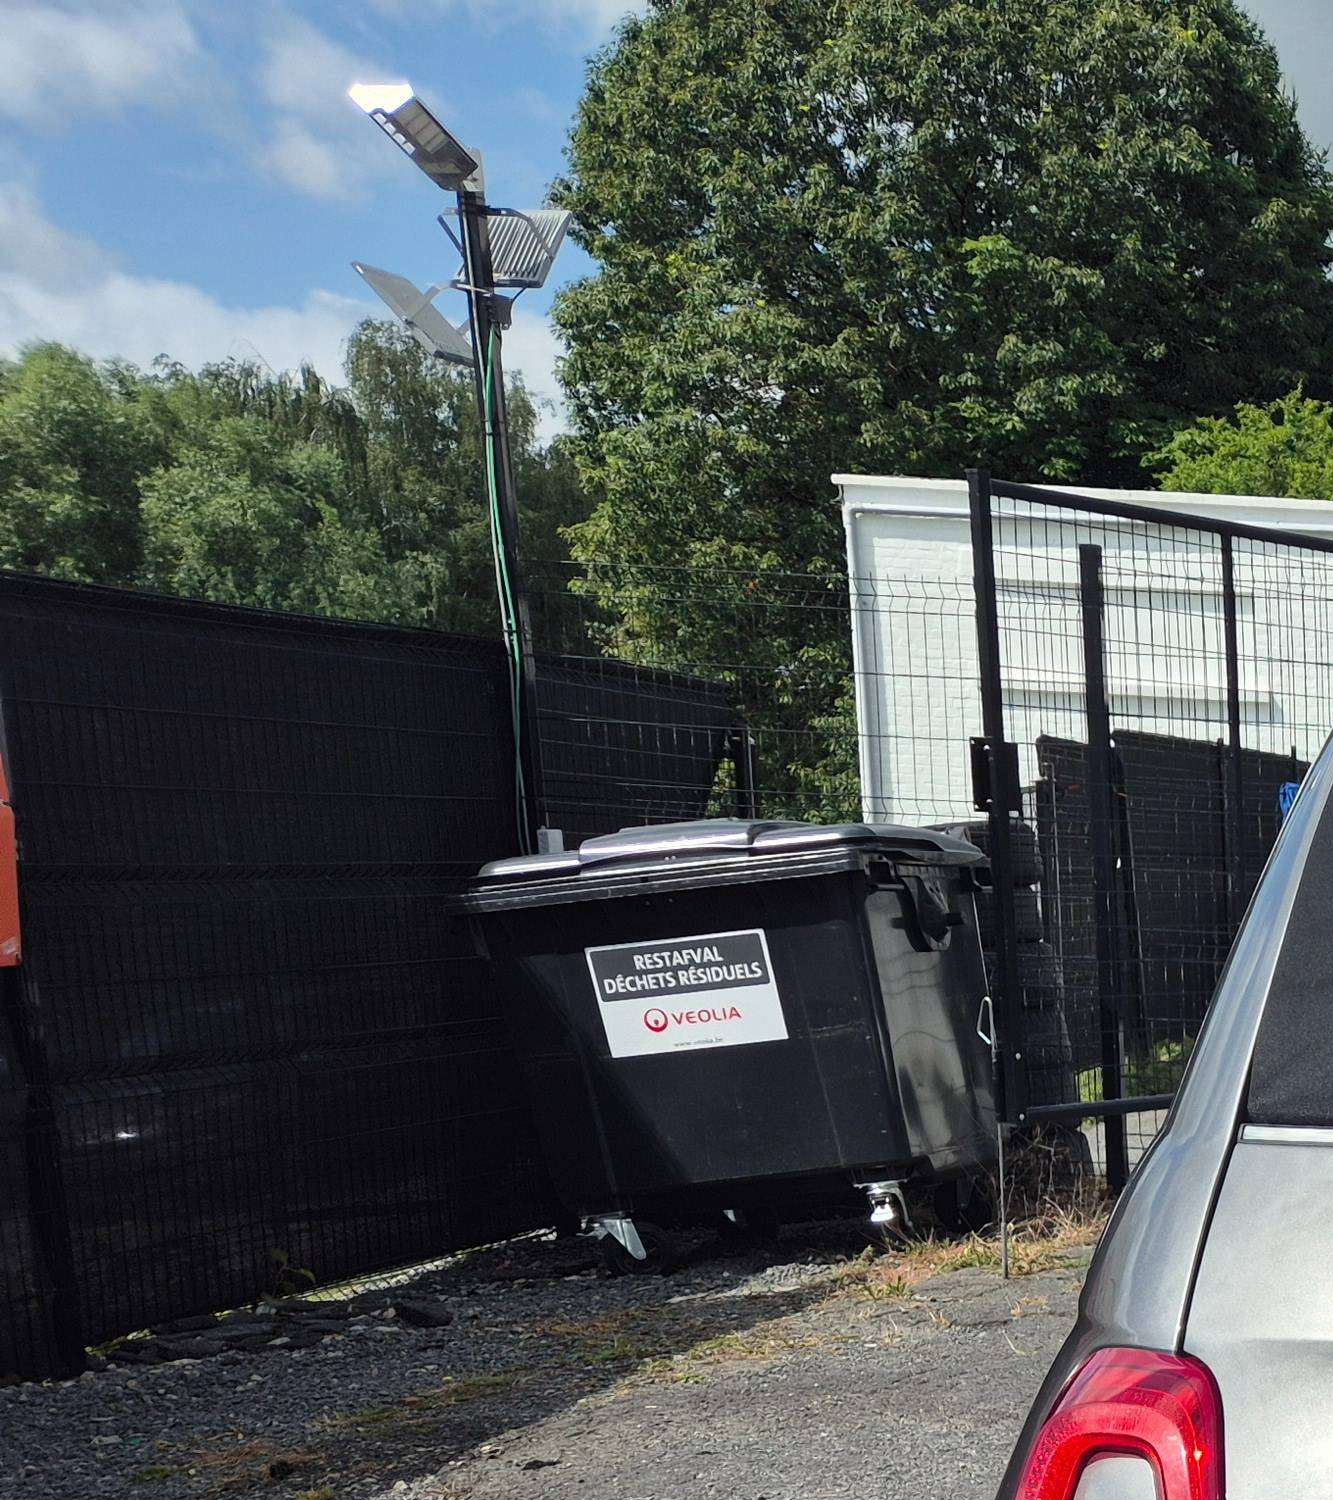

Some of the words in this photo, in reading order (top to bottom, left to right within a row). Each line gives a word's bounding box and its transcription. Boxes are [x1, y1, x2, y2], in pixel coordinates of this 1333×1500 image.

[633, 945, 724, 970] RESTAFVAL
[603, 971, 676, 994] DÉCHETS
[678, 961, 763, 986] RÉSIDUELS
[671, 1006, 742, 1026] VEOLIA
